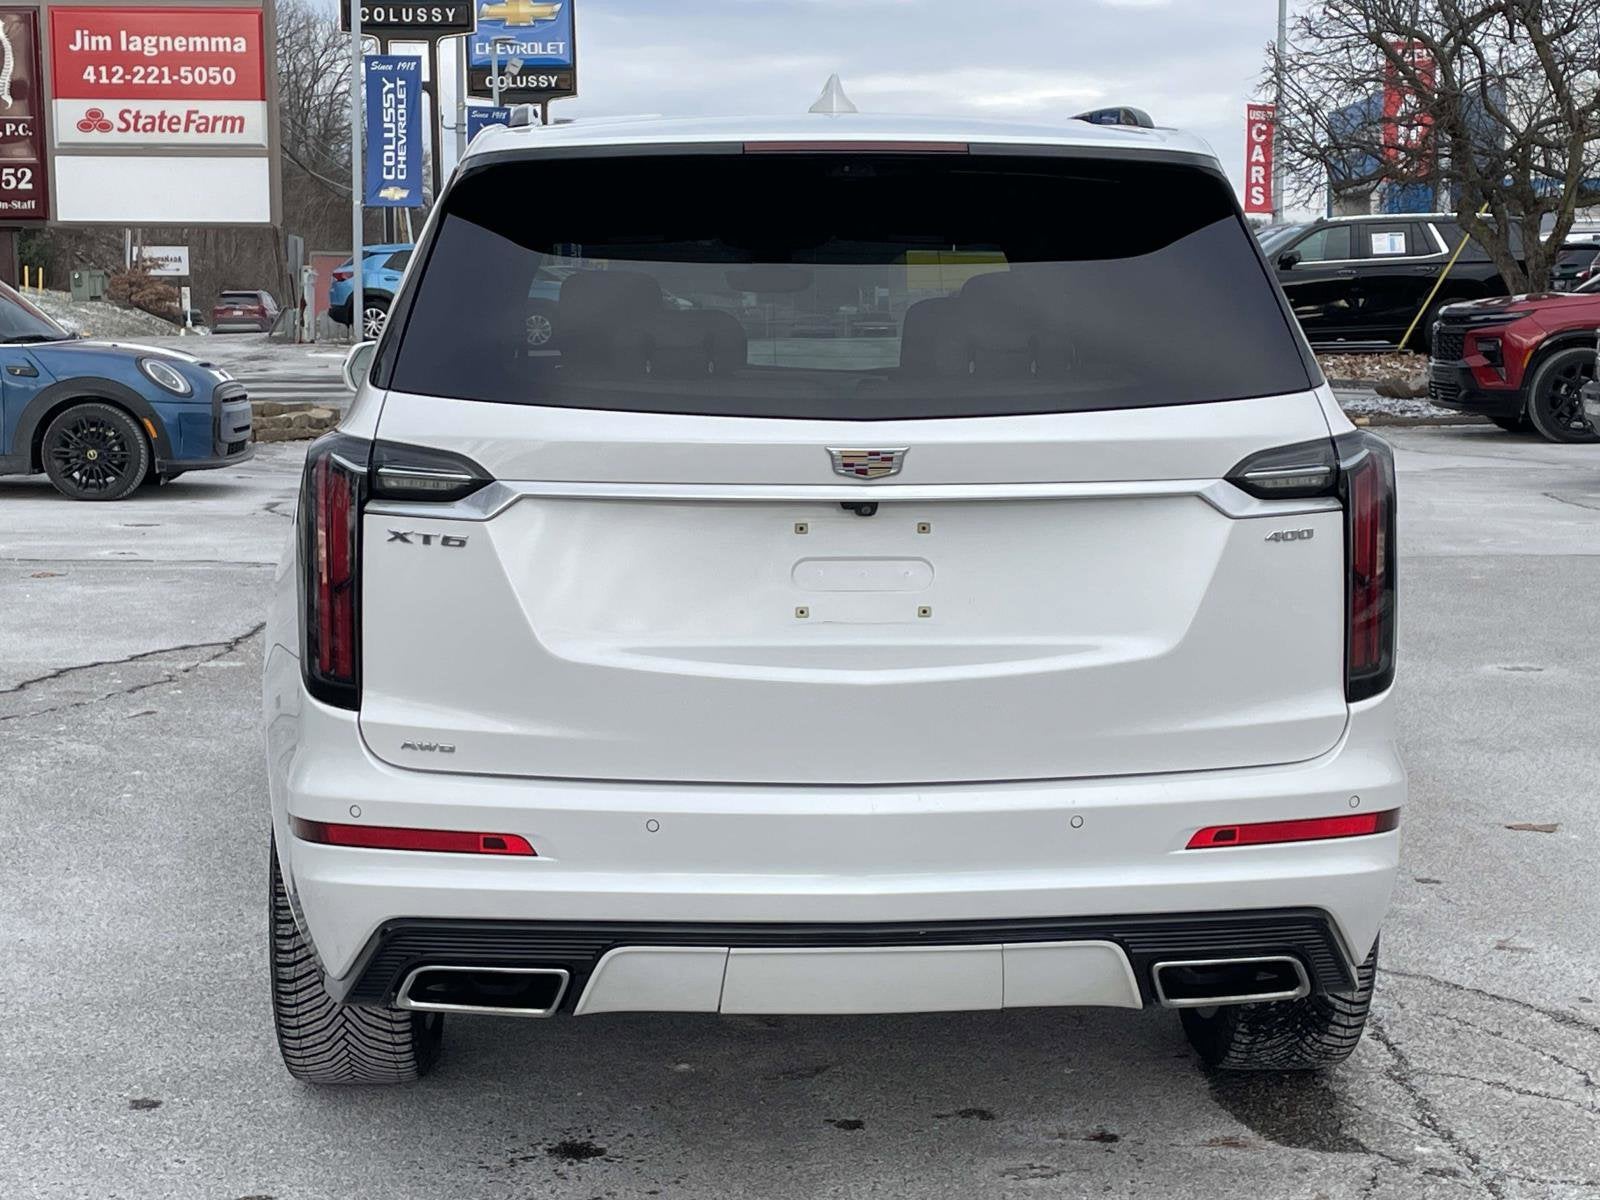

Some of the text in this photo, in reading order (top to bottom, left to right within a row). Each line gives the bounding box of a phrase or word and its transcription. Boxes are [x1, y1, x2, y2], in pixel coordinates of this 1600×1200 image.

[360, 7, 455, 22] COLUSSY
[69, 30, 246, 56] Jim Iagnemma
[476, 41, 565, 55] CHEVROLET
[370, 60, 417, 71] Since 1918
[83, 65, 236, 85] 412-221-5050
[485, 75, 557, 88] COLUSSY
[471, 110, 489, 119] Since
[5, 123, 33, 136] P.C.
[382, 77, 395, 181] COLUSSY
[396, 77, 406, 180] CHEVROLET
[1251, 123, 1267, 205] CARS
[1, 167, 33, 190] 52
[387, 530, 468, 548] XT6
[1264, 528, 1314, 543] 400
[400, 741, 456, 754] AWD
